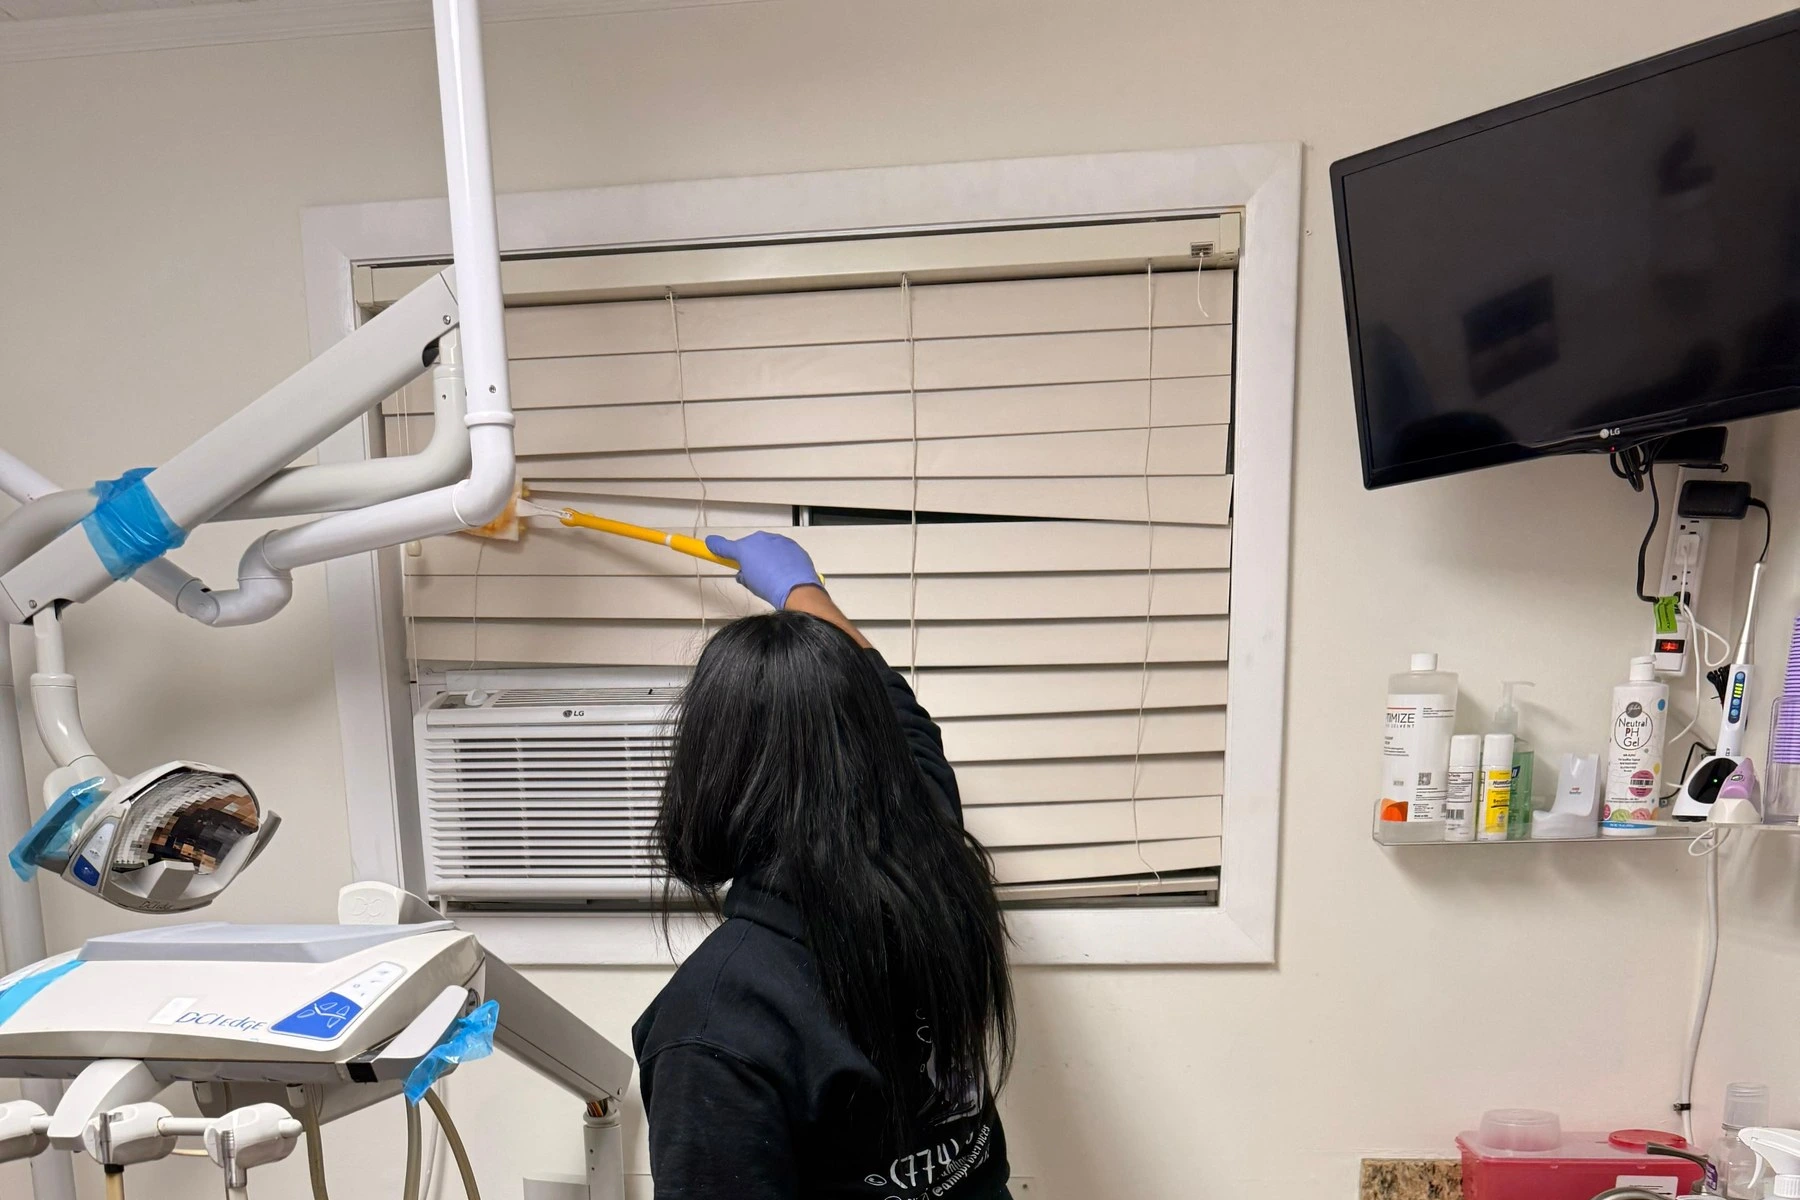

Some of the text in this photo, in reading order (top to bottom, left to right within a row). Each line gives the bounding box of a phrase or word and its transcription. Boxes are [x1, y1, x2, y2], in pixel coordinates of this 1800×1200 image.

[1610, 427, 1620, 436] LG
[1618, 717, 1648, 728] Neutral
[1624, 727, 1640, 737] PH
[1623, 736, 1640, 748] Gel
